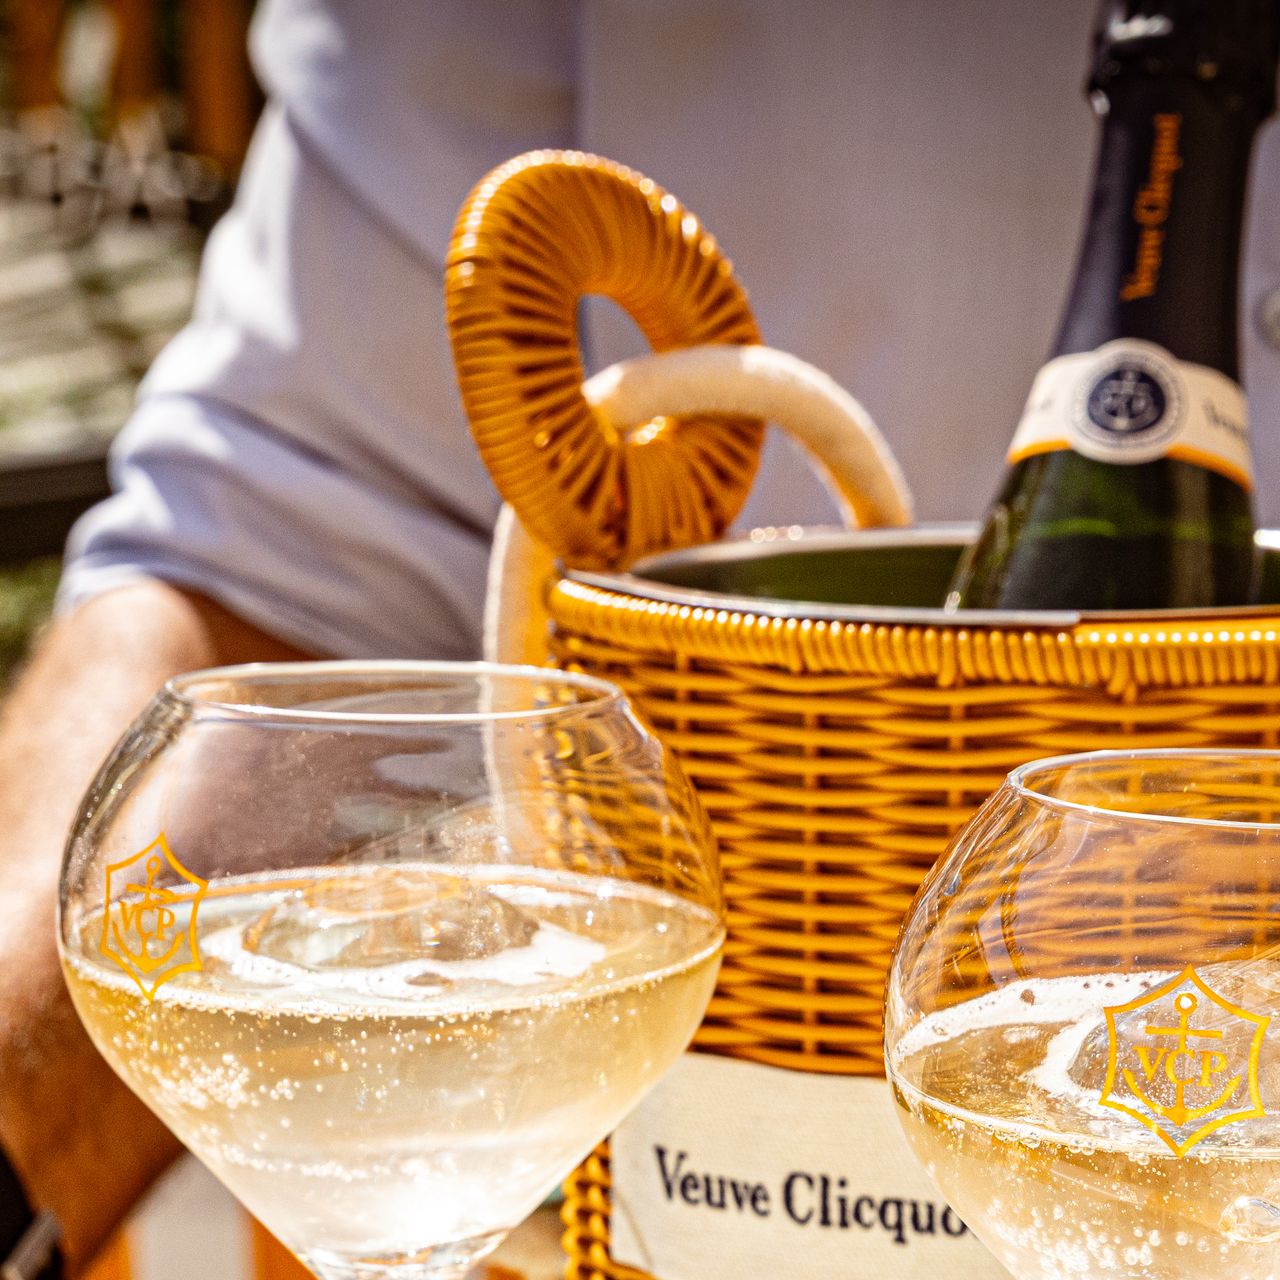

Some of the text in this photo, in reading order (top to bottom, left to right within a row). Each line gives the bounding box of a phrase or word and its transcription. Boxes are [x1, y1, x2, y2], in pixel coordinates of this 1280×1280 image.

[119, 900, 176, 941] VCP
[1132, 1046, 1229, 1088] VCP
[654, 1145, 970, 1245] Veuve Clicquo
